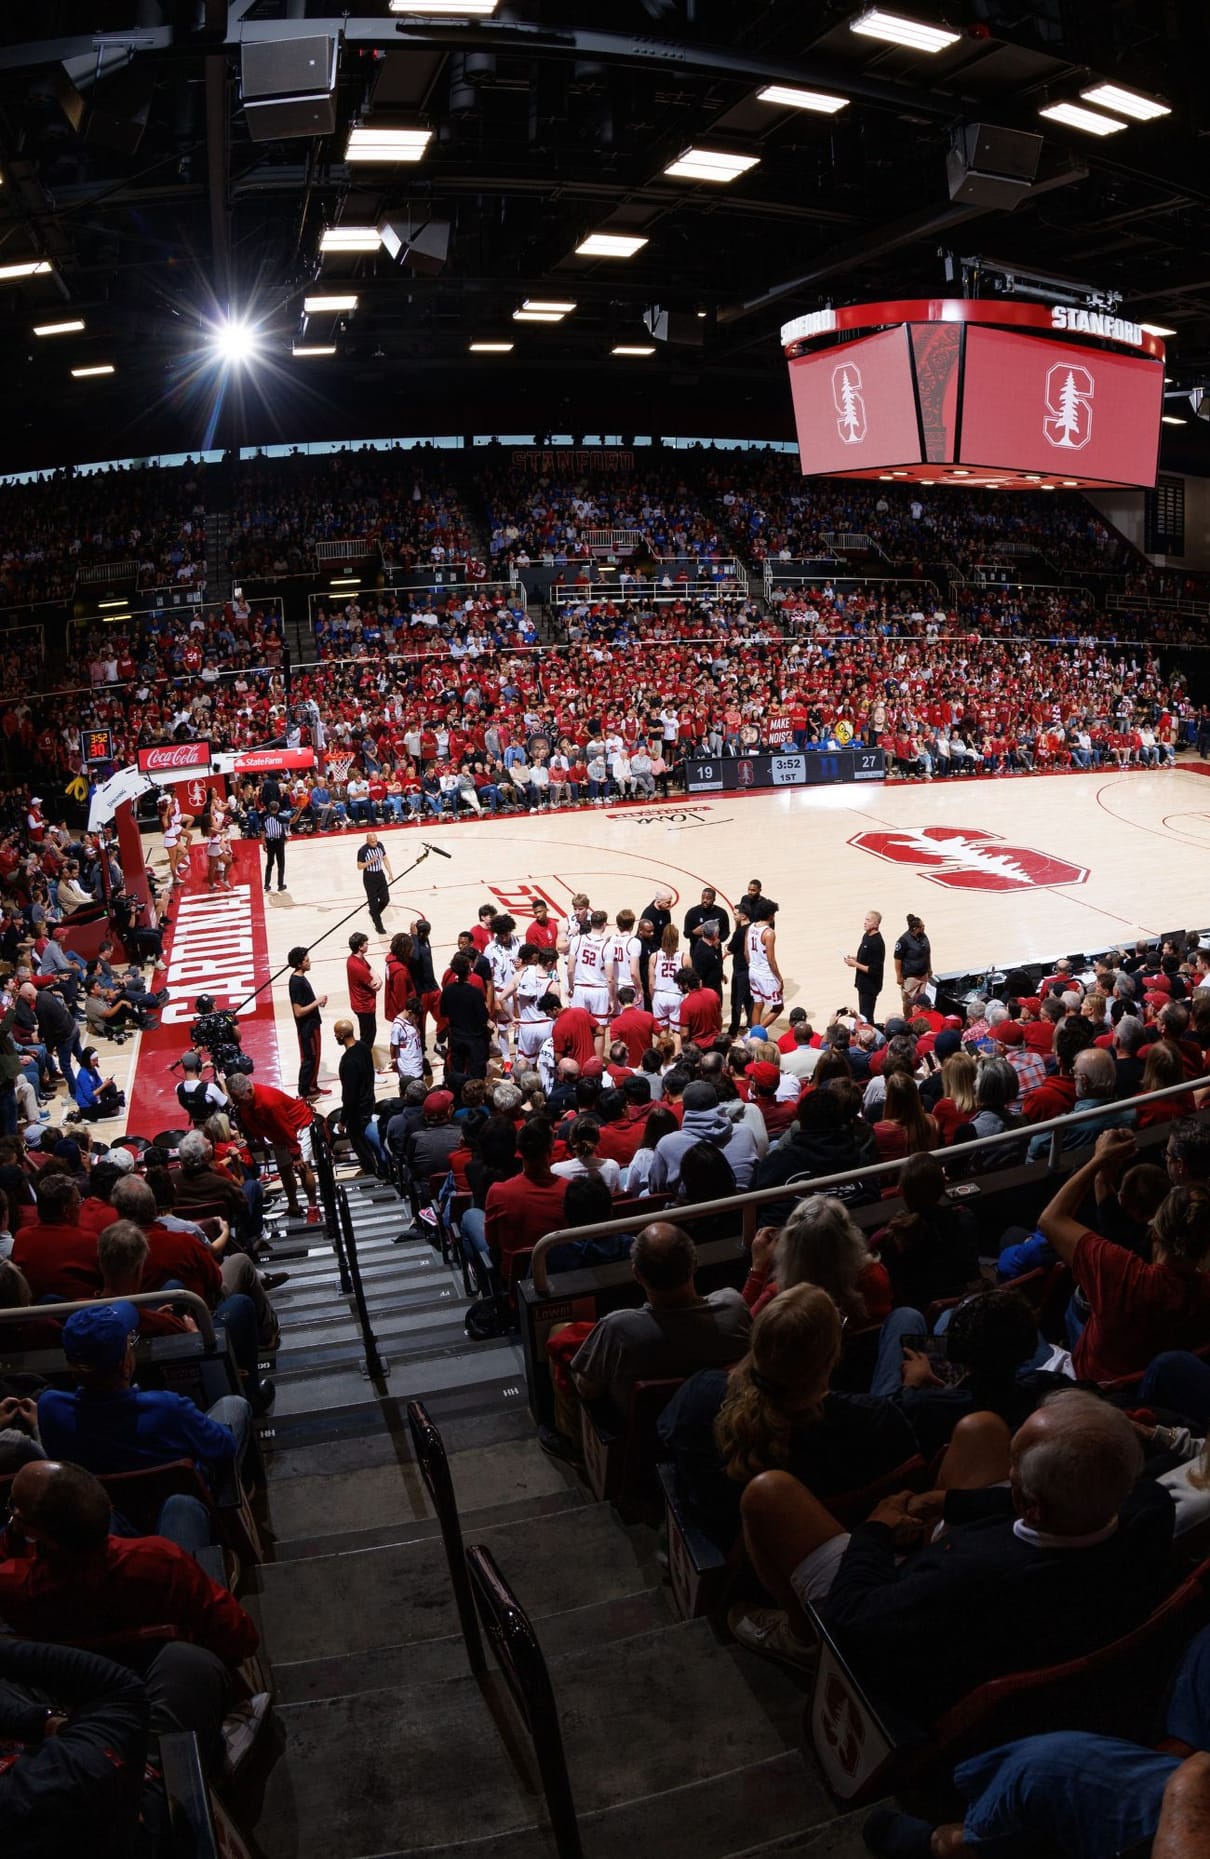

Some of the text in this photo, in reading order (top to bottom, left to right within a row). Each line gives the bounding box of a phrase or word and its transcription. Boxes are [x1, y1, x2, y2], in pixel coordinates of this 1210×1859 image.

[1051, 305, 1143, 346] STANFORD
[511, 449, 637, 473] STANFORD
[769, 717, 791, 731] MAKE
[90, 733, 108, 744] 3:52
[90, 744, 105, 757] 30
[776, 759, 801, 769] 3:52
[861, 755, 877, 768] 27
[696, 766, 713, 780] 19
[780, 773, 797, 782] 1ST
[582, 950, 597, 967] 52
[661, 963, 677, 978] 25
